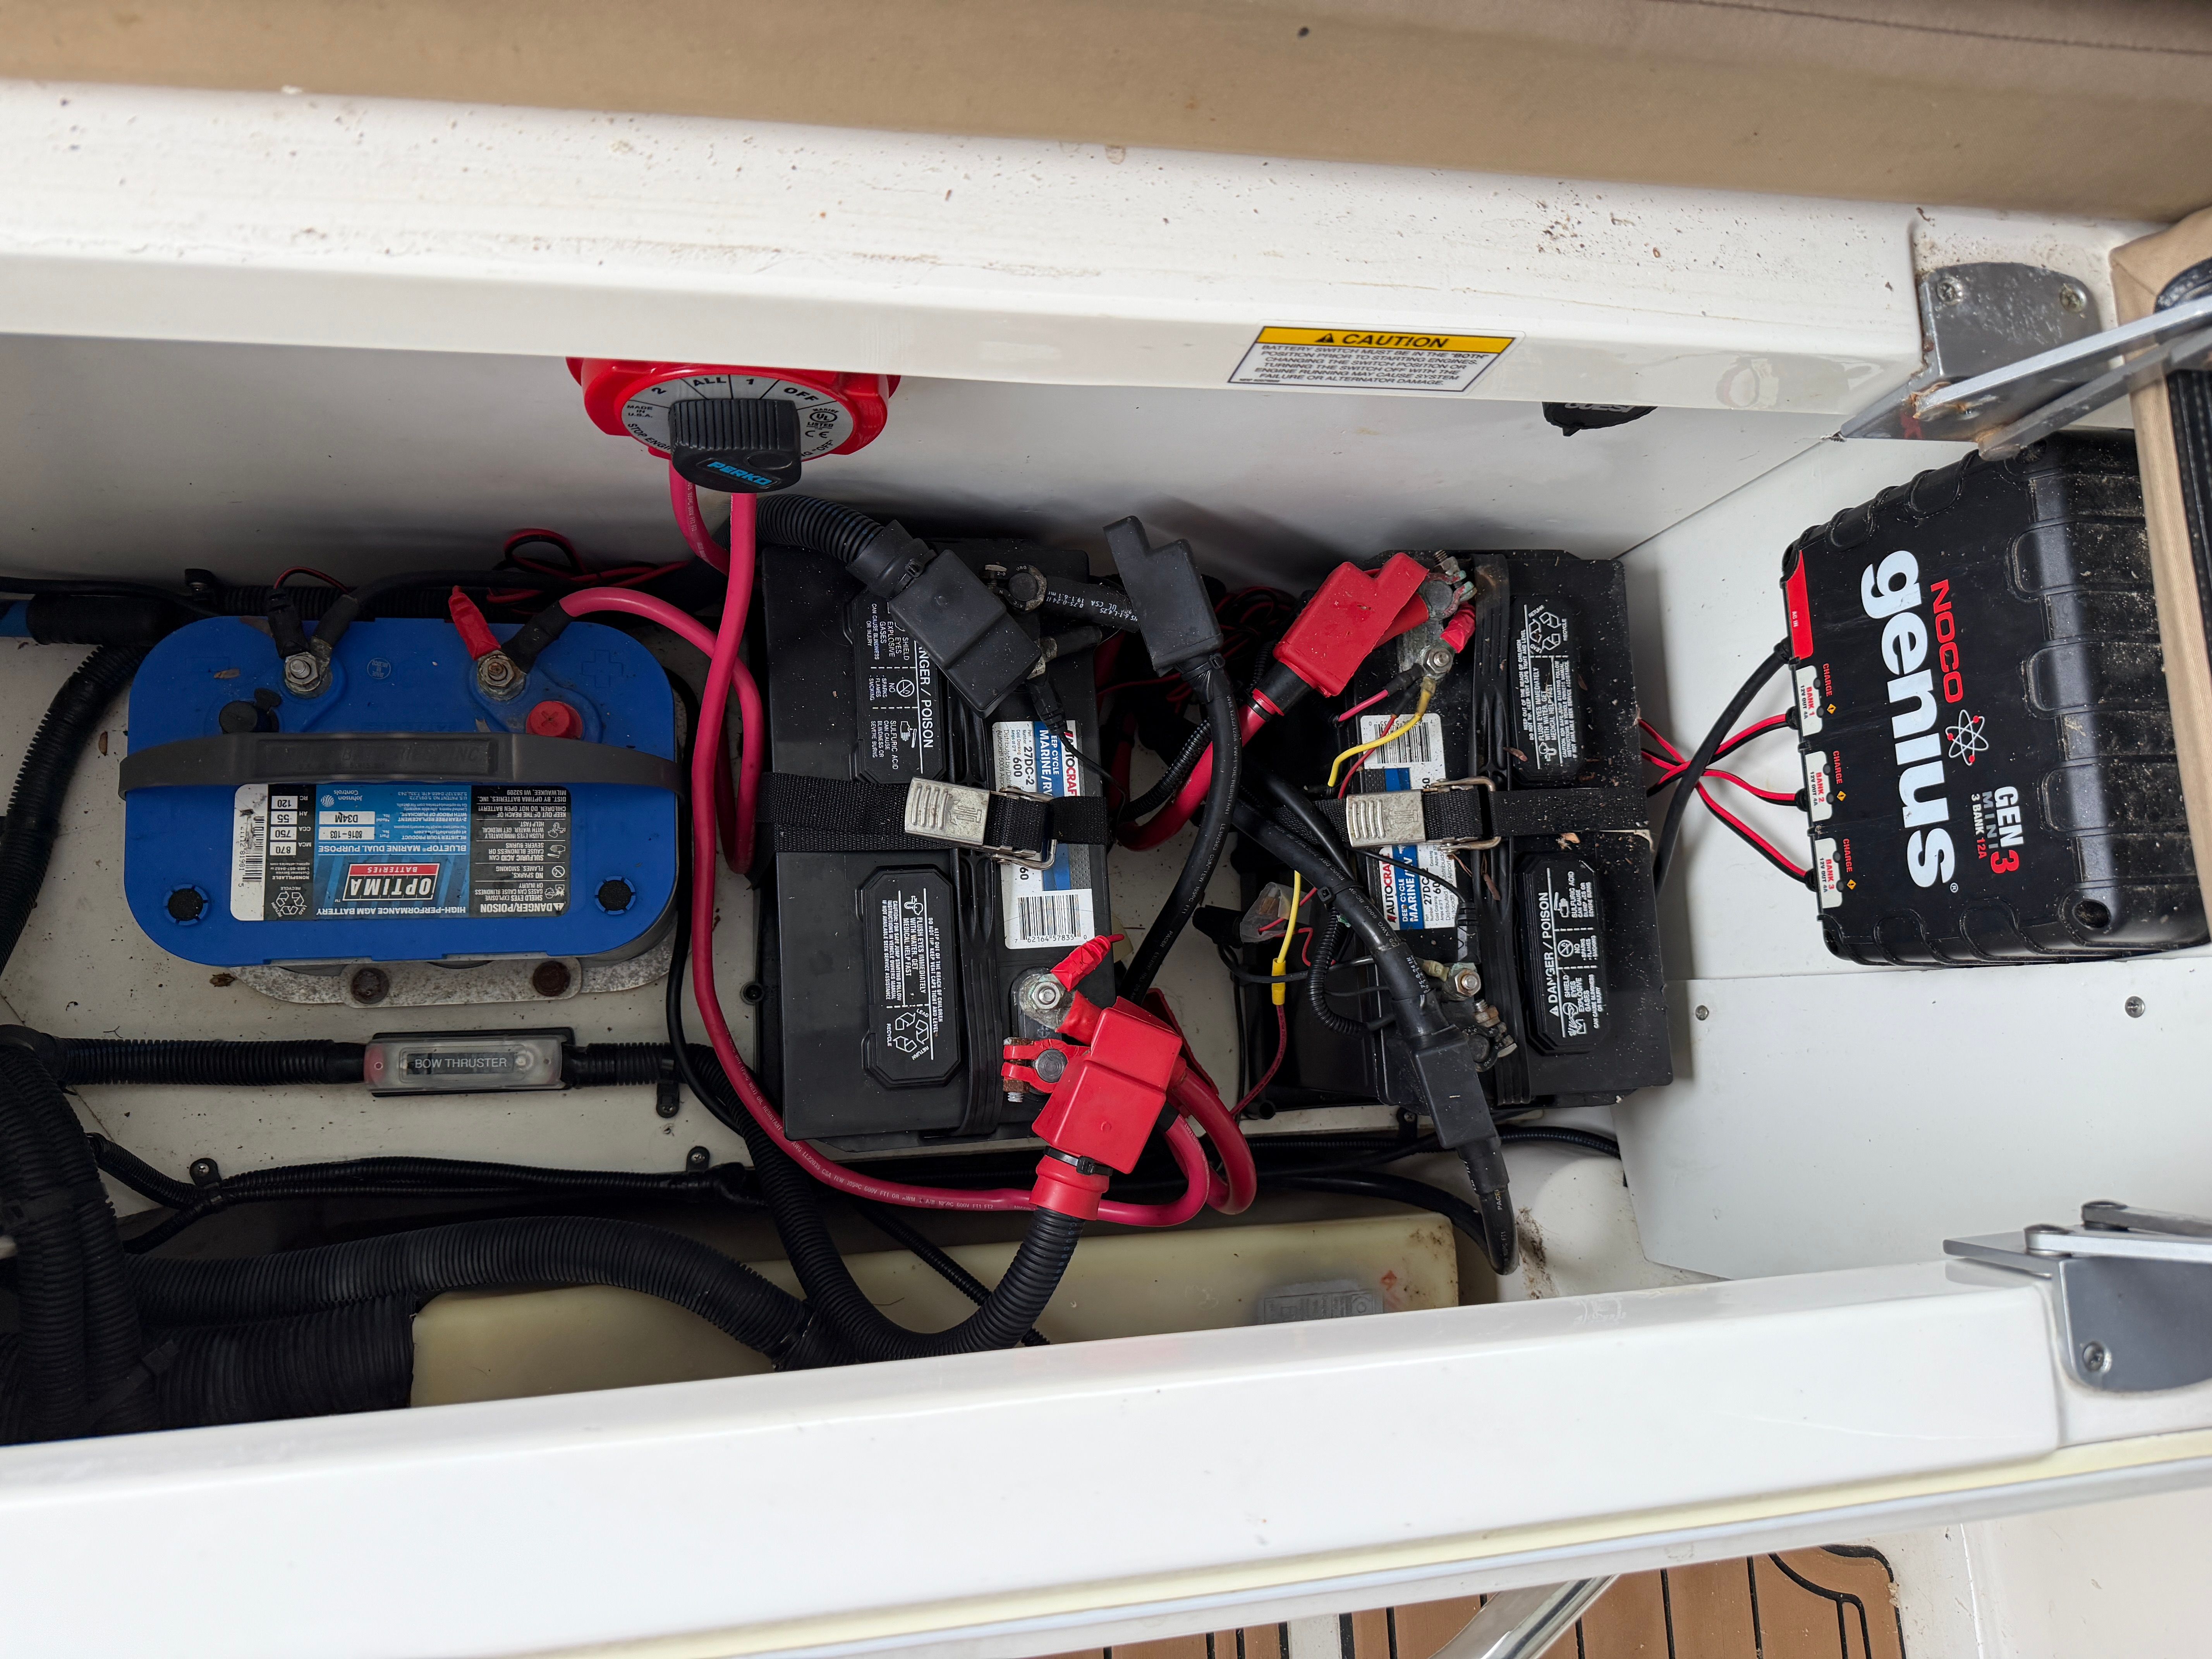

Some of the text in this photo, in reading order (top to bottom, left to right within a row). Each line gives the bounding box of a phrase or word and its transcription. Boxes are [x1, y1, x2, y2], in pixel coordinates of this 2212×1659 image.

[1343, 333, 1449, 347] CAUTION
[693, 377, 726, 386] ALL
[784, 387, 819, 401] OFF
[627, 423, 647, 437] STOP
[707, 462, 773, 486] PERKO
[1791, 611, 1797, 619] AC
[1930, 579, 1963, 703] NOCO
[889, 683, 895, 692] NO
[1822, 663, 1832, 697] CHARGE
[1806, 686, 1814, 709] BANK
[921, 700, 933, 748] POISON
[1803, 711, 1808, 719] 4A
[1860, 550, 1955, 888] genius
[1013, 757, 1023, 777] 600
[1024, 746, 1034, 785] 27DC-2
[1833, 750, 1843, 784] CHARGE
[1816, 772, 1824, 795] BANK
[277, 799, 292, 807] 120
[1813, 798, 1818, 806] 4A
[277, 814, 289, 823] 55
[335, 814, 358, 823] D34M
[1972, 804, 1984, 835] BANK
[1982, 791, 1998, 849] MINI
[1990, 786, 2024, 874] GEN 3
[1843, 838, 1853, 872] CHARGE
[1977, 837, 1987, 859] 12A
[1826, 859, 1834, 881] BANK
[350, 878, 432, 895] OPTIMA
[1822, 884, 1828, 893] 4A
[480, 903, 553, 913] DANGER/POISON
[1569, 888, 1578, 918] SULFURIC
[1538, 892, 1558, 1003] DANGER POISON
[415, 1058, 507, 1068] BOW THRUSTER
[791, 1141, 803, 1152] AWG
[822, 1168, 831, 1178] CSA
